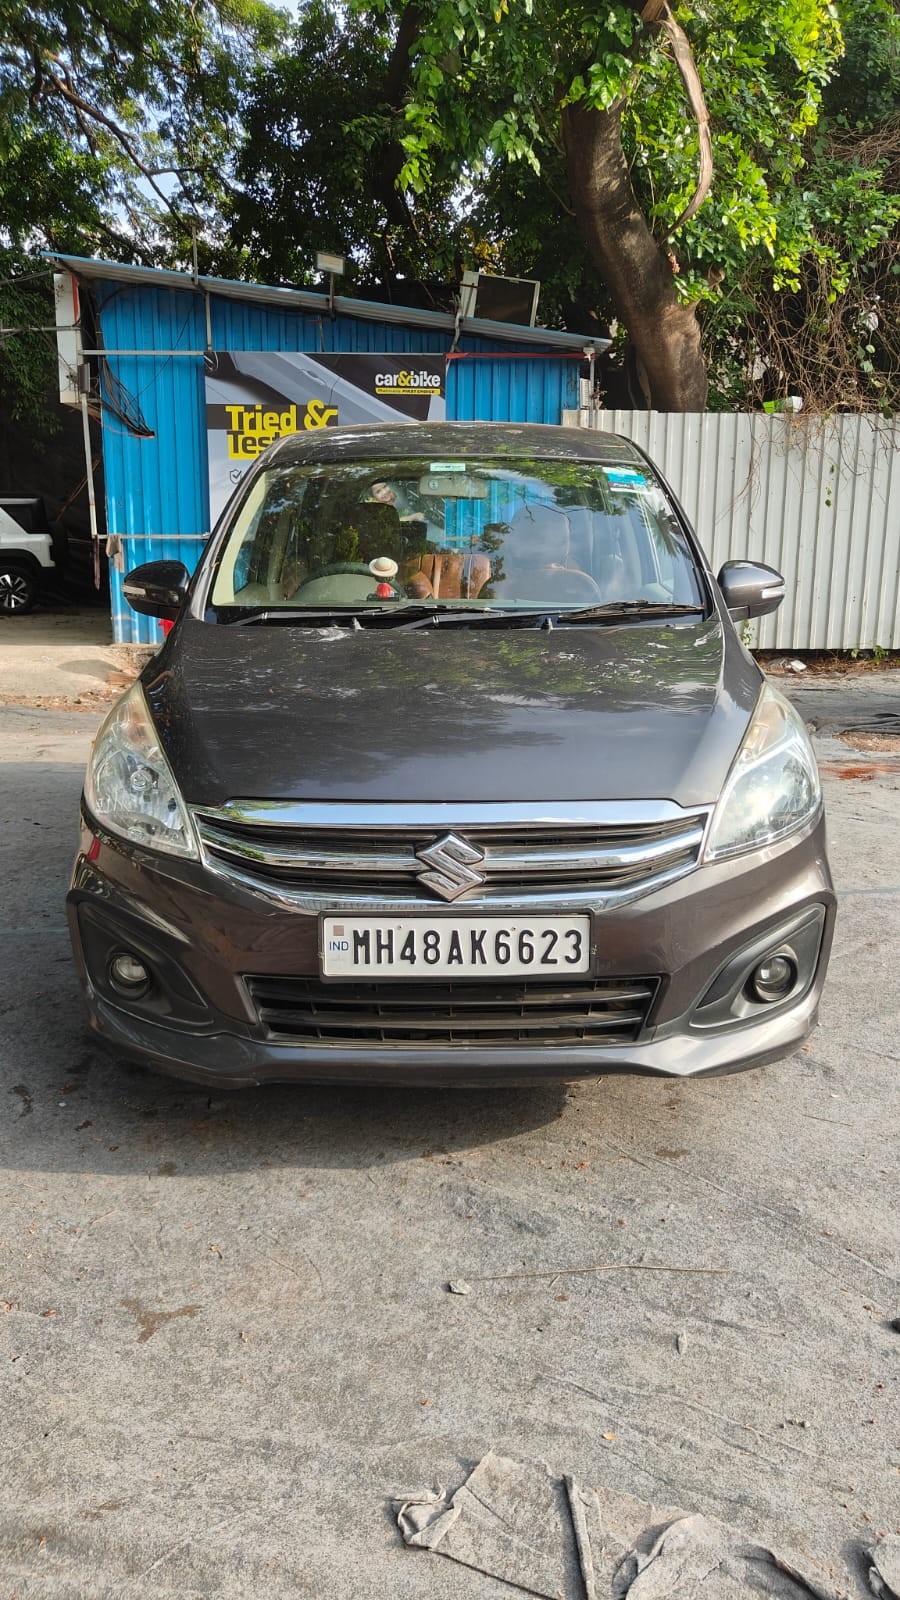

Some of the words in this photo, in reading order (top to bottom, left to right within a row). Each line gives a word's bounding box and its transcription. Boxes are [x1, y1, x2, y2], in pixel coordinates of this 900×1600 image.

[375, 370, 440, 386] car&bike
[226, 404, 297, 431] Tried
[304, 399, 338, 430] &
[329, 941, 349, 951] IND
[353, 929, 582, 965] MH48AK6623
